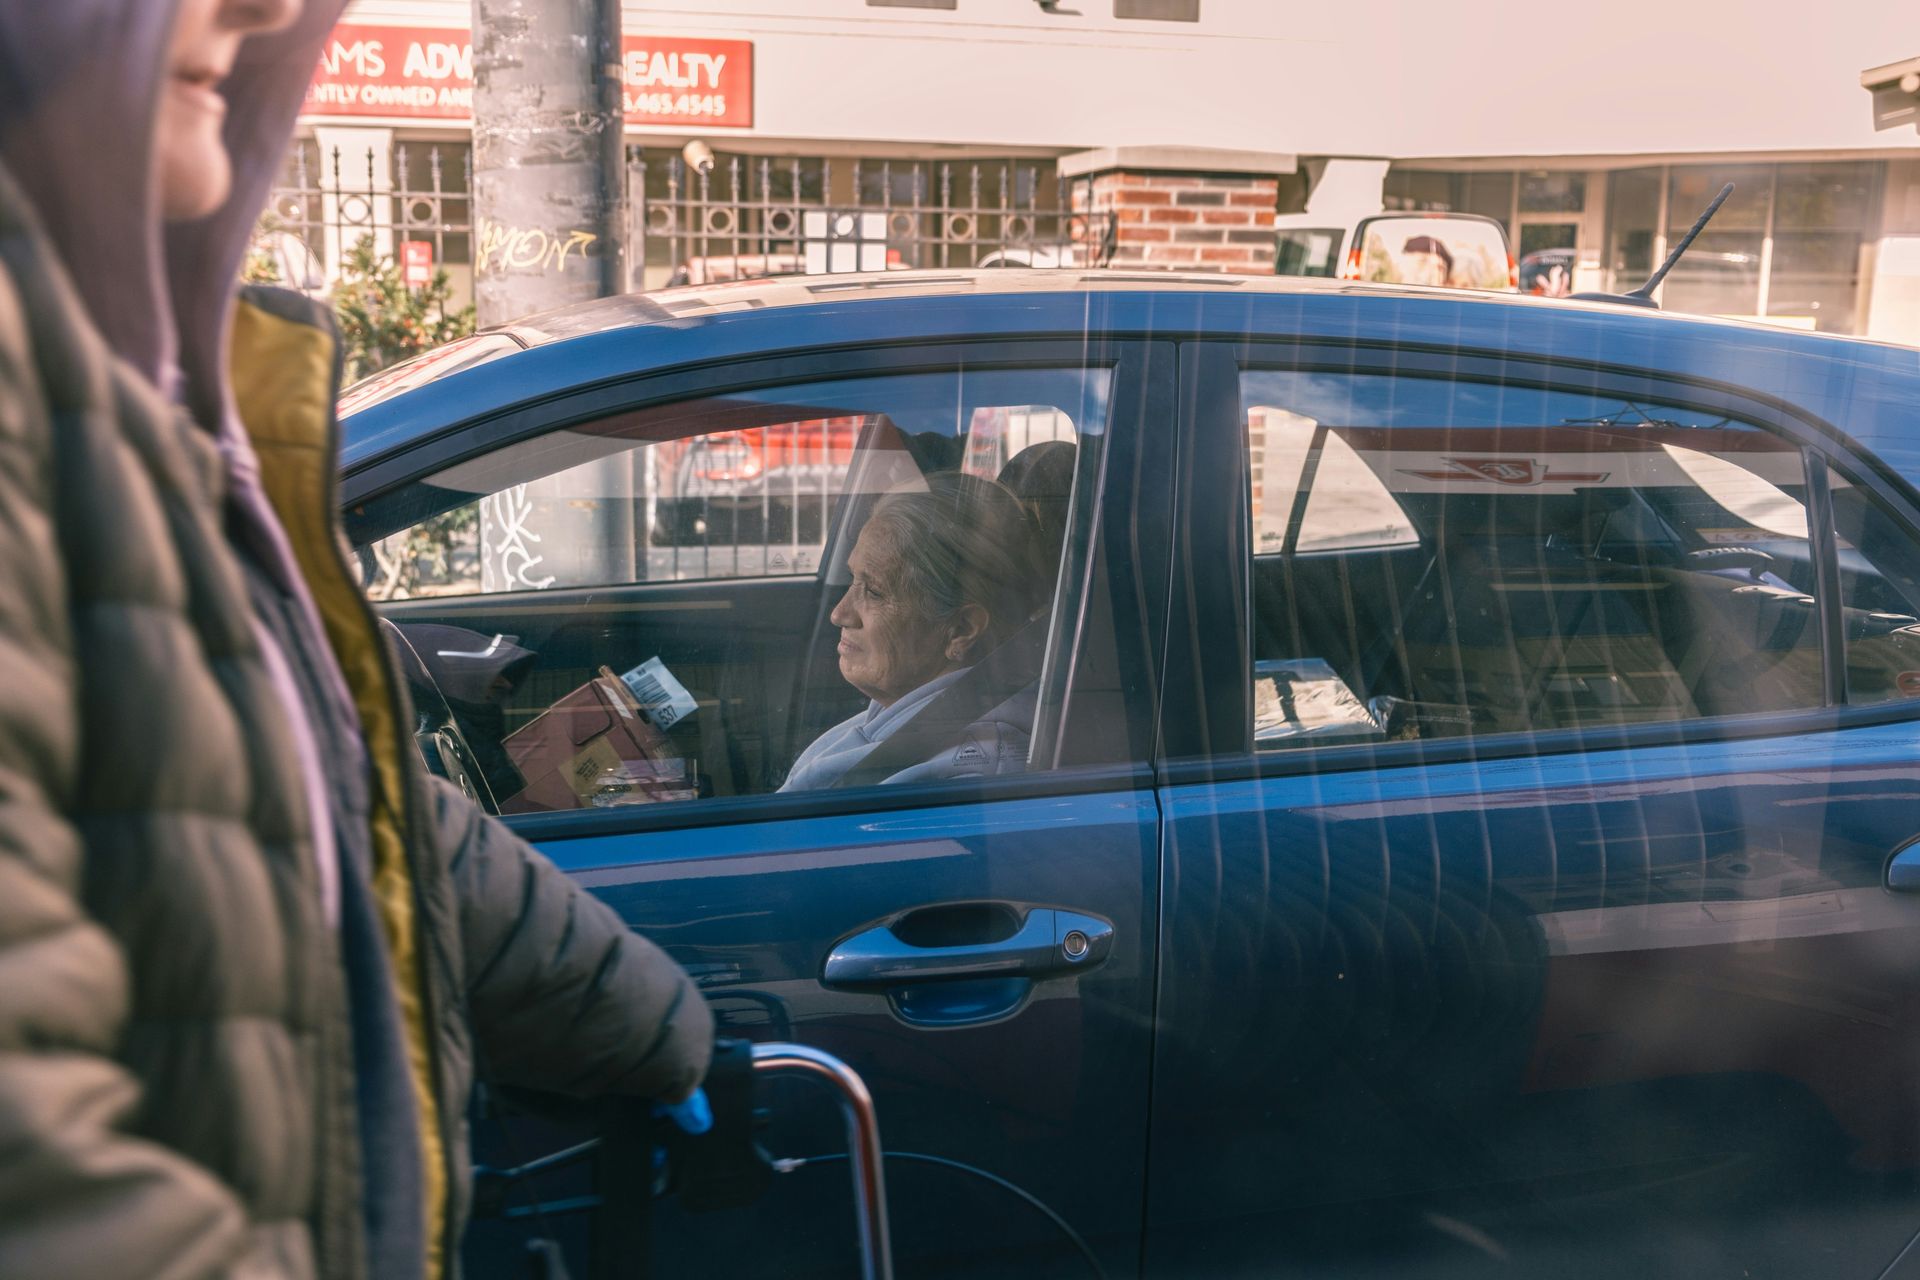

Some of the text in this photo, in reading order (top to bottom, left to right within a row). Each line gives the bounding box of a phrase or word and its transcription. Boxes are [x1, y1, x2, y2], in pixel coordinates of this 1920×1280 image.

[623, 50, 727, 89] EALTY
[361, 84, 437, 107] OWNED
[658, 704, 678, 726] 537
